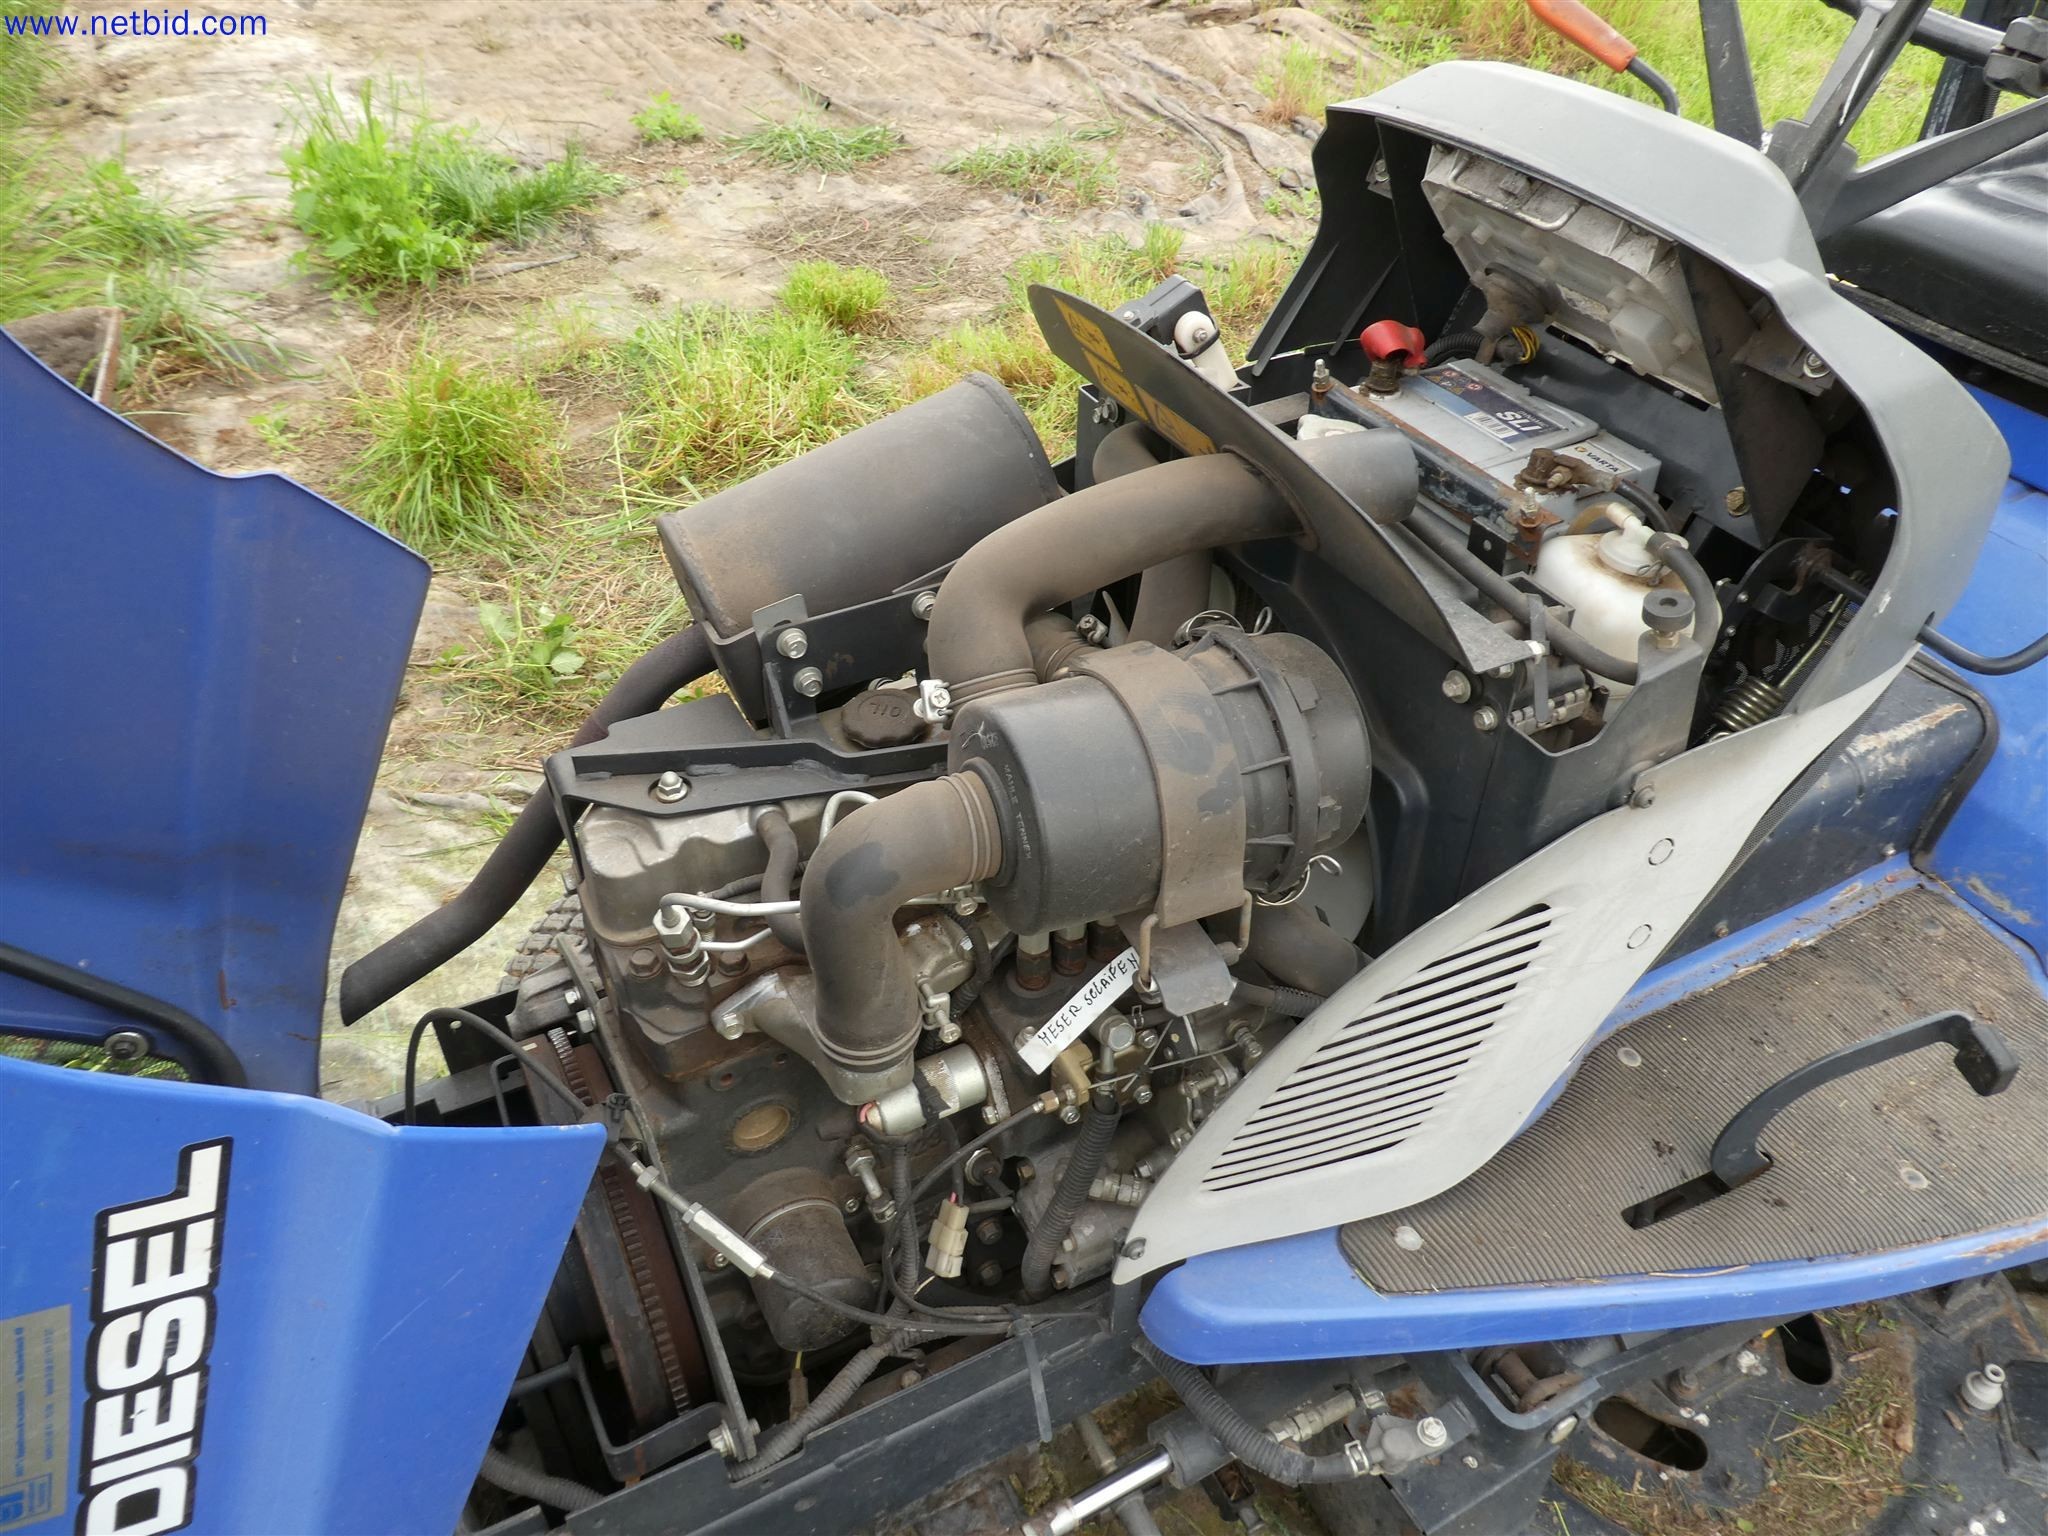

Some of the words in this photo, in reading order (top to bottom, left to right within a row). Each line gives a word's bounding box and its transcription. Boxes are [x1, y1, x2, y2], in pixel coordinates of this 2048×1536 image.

[1495, 411, 1542, 431] SLI
[1586, 452, 1620, 472] VARTA
[1002, 764, 1019, 804] MAHLE
[82, 1140, 228, 1536] DIESEL
